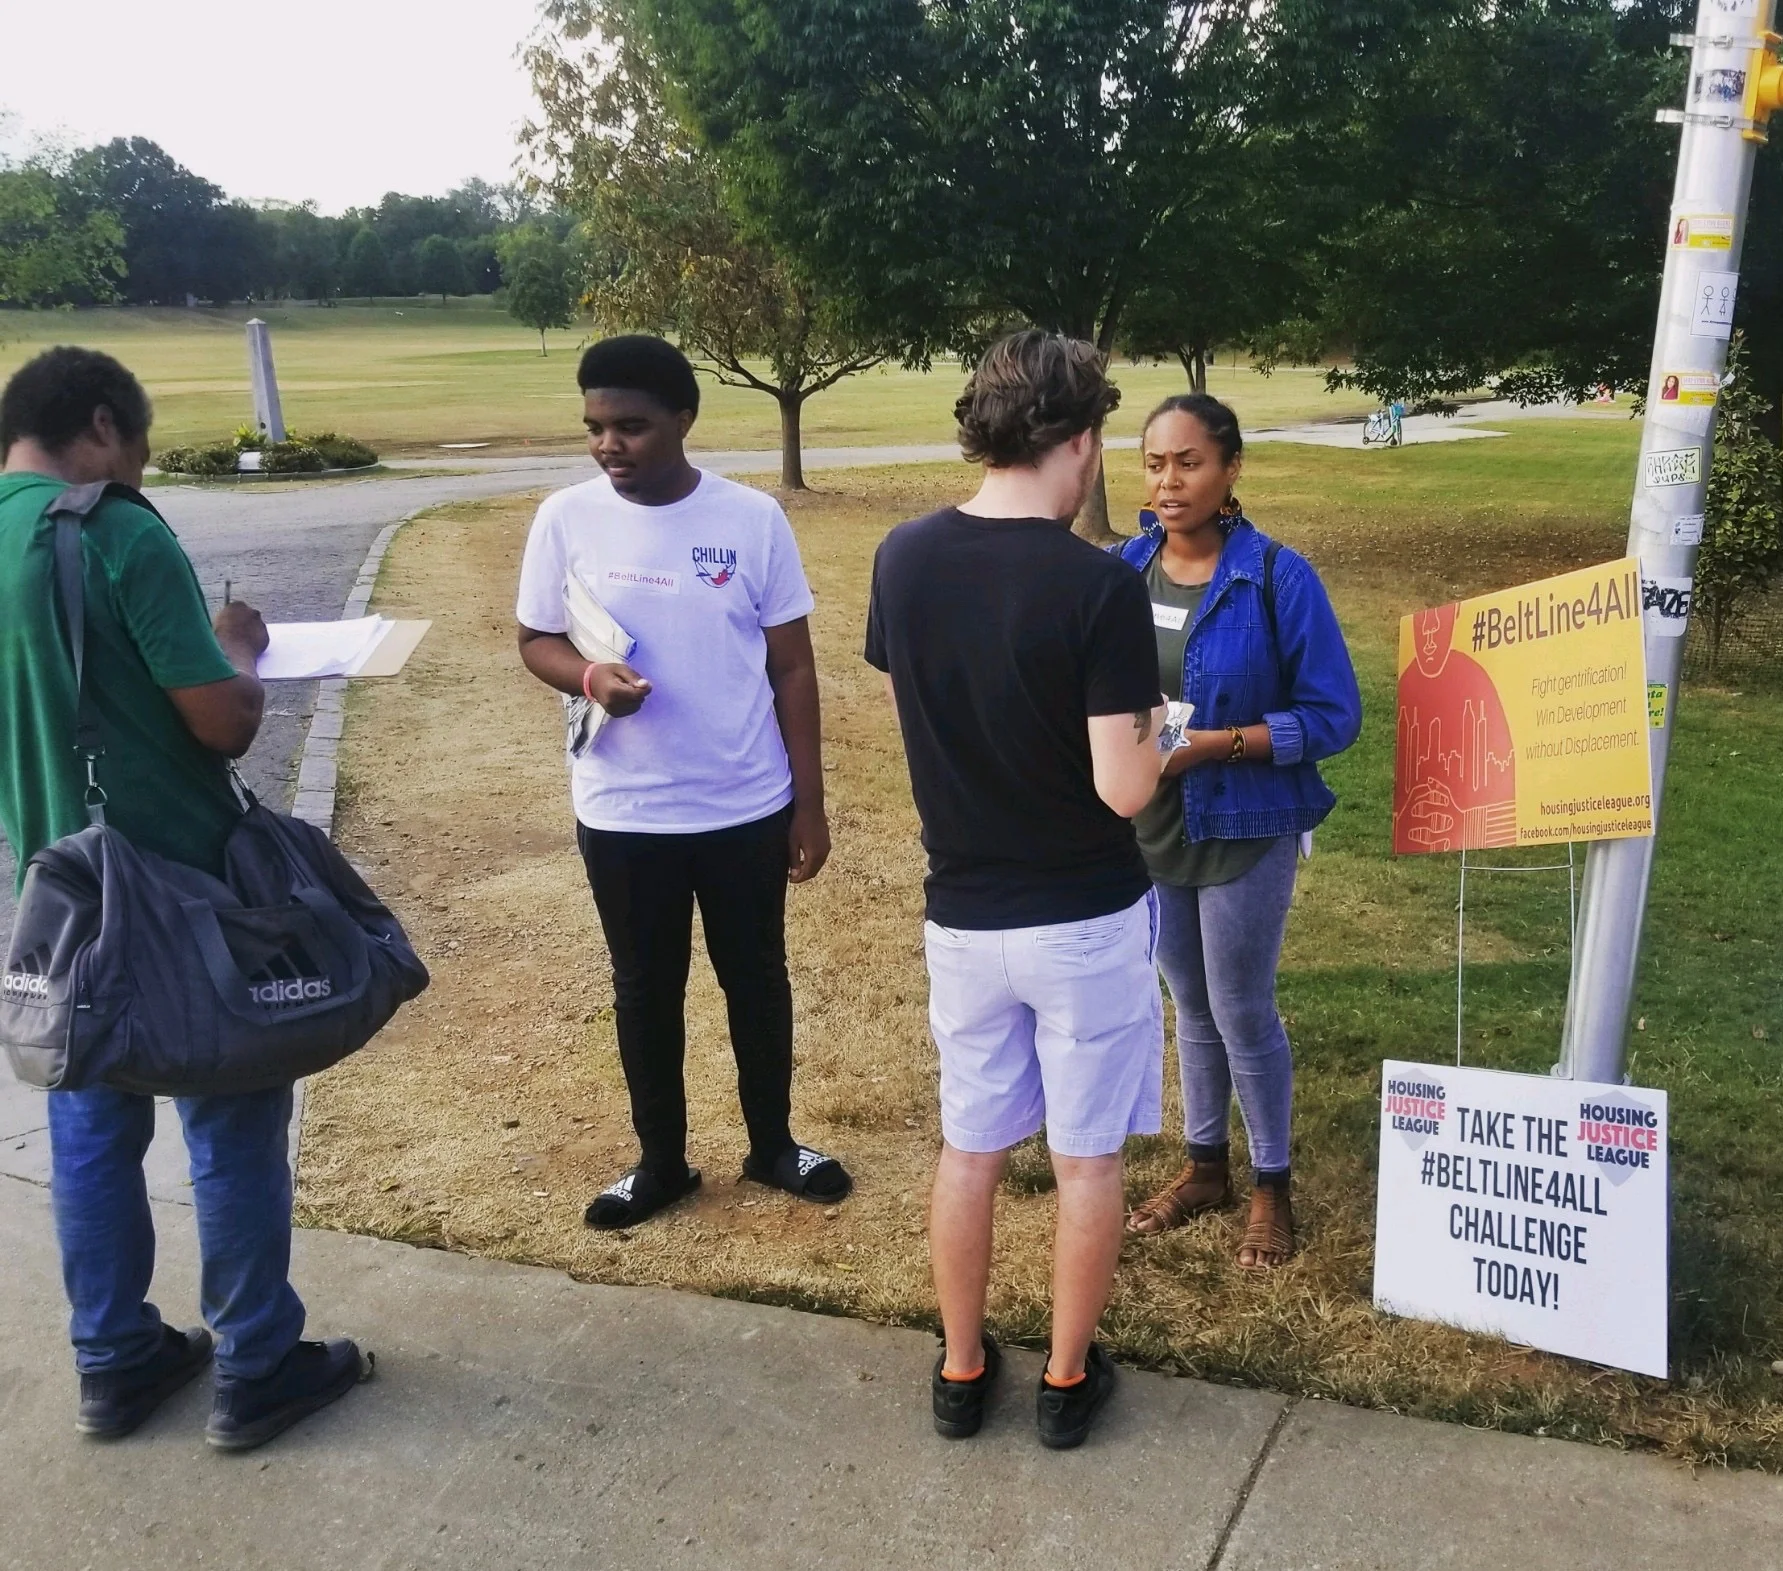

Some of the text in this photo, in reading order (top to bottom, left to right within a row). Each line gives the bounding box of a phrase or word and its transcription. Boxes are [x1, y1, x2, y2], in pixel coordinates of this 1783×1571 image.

[692, 547, 737, 566] CHILLIN
[608, 571, 674, 587] #BeltLine4All
[1471, 571, 1639, 652] #BeltLine4All
[1531, 662, 1627, 699] Fight gentrification!
[1536, 697, 1627, 727] Win Development
[1525, 729, 1639, 761] without Displacement.
[1540, 793, 1650, 816] housingjusticeleague.org
[1520, 818, 1651, 840] facebook.com/housingjusticeleague
[4, 972, 48, 993] adida
[1387, 1079, 1446, 1100] HOUSING
[1385, 1094, 1446, 1121] JUSTICE
[1580, 1103, 1658, 1128] HOUSING
[1391, 1116, 1439, 1136] LEAGUE
[1457, 1106, 1568, 1158] TAKE THE
[1576, 1121, 1658, 1151] JUSTICE
[1586, 1145, 1650, 1169] LEAGUE
[1421, 1150, 1608, 1216] #BELTLINE4ALL
[1449, 1203, 1588, 1265] CHALLENGE
[1473, 1256, 1559, 1311] TODAY!
